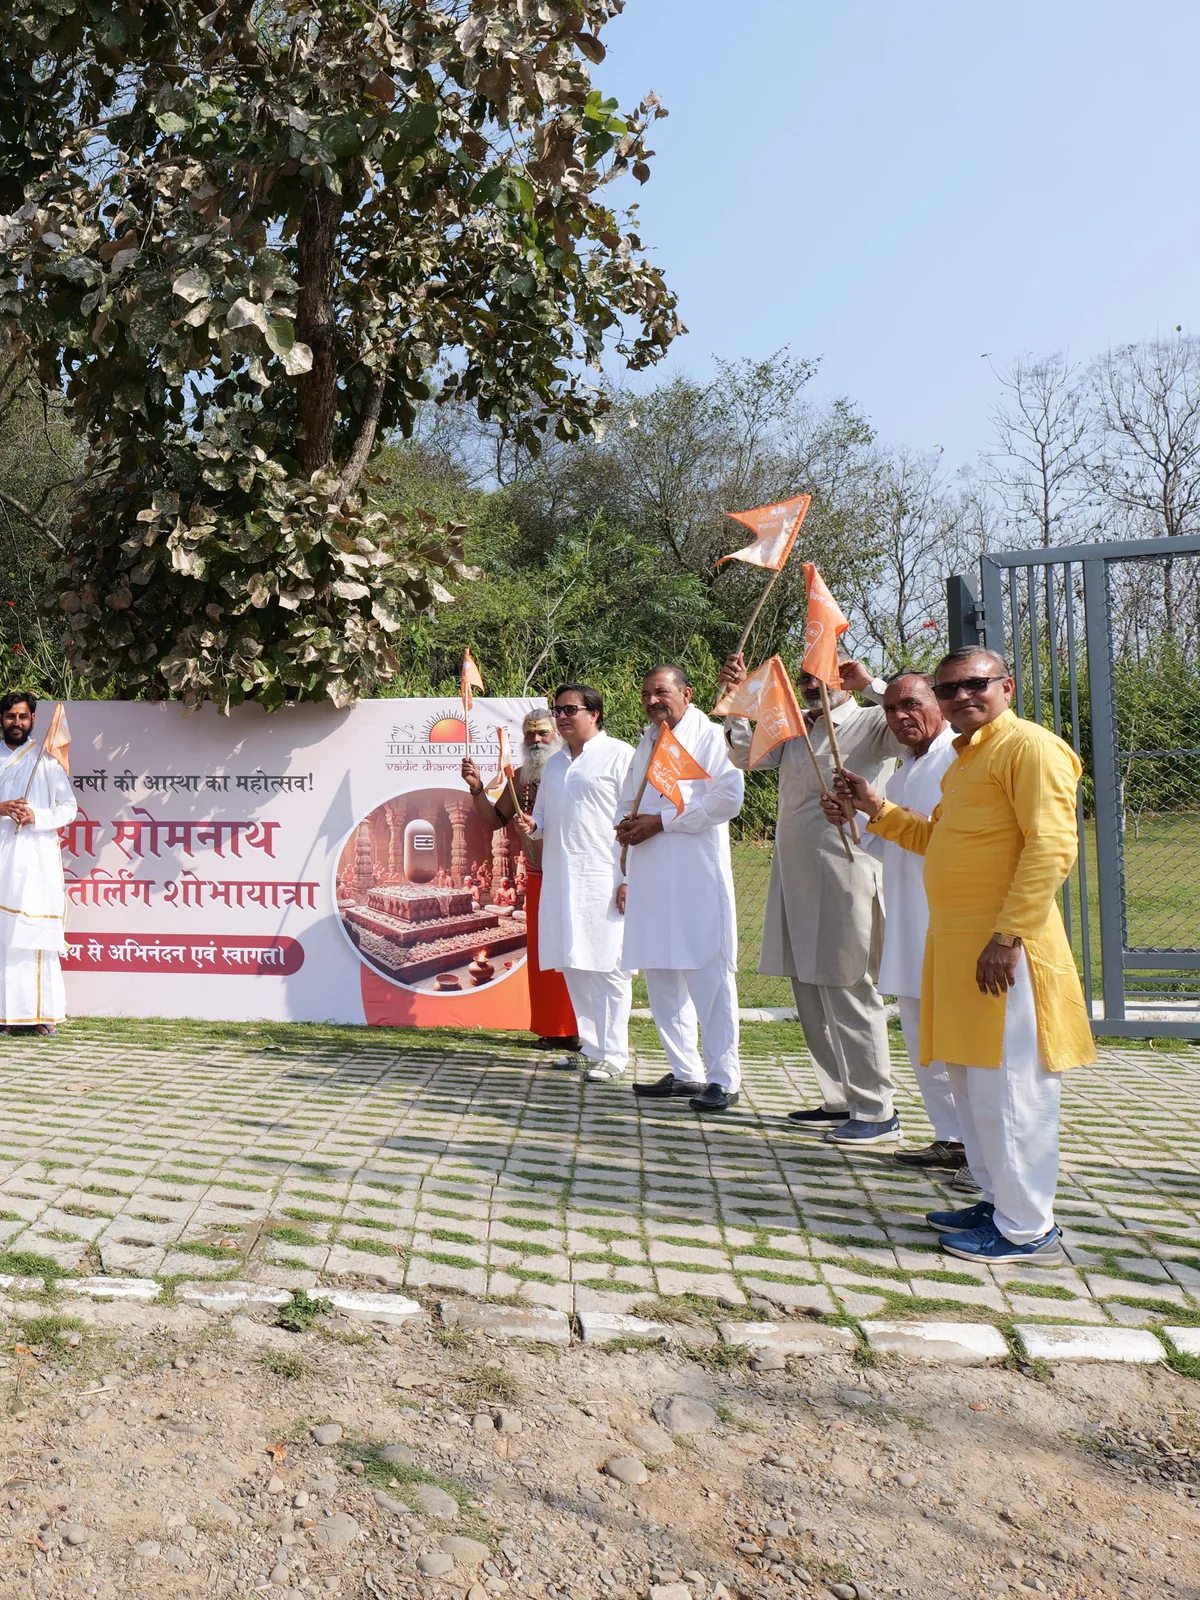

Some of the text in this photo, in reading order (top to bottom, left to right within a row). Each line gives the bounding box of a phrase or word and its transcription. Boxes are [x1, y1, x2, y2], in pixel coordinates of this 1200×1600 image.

[387, 744, 414, 754] THE
[418, 744, 444, 754] ART
[447, 744, 465, 754] OF
[386, 759, 418, 772] vaidic
[73, 769, 313, 794] वर्षों की आस्था का महोत्सव!
[111, 806, 281, 861] सोमनाथ
[163, 869, 321, 910] शोभायात्रा
[87, 938, 104, 962] से
[108, 938, 186, 964] अभिनंदन
[191, 940, 216, 968] एवं
[221, 945, 285, 966] स्वागत।
